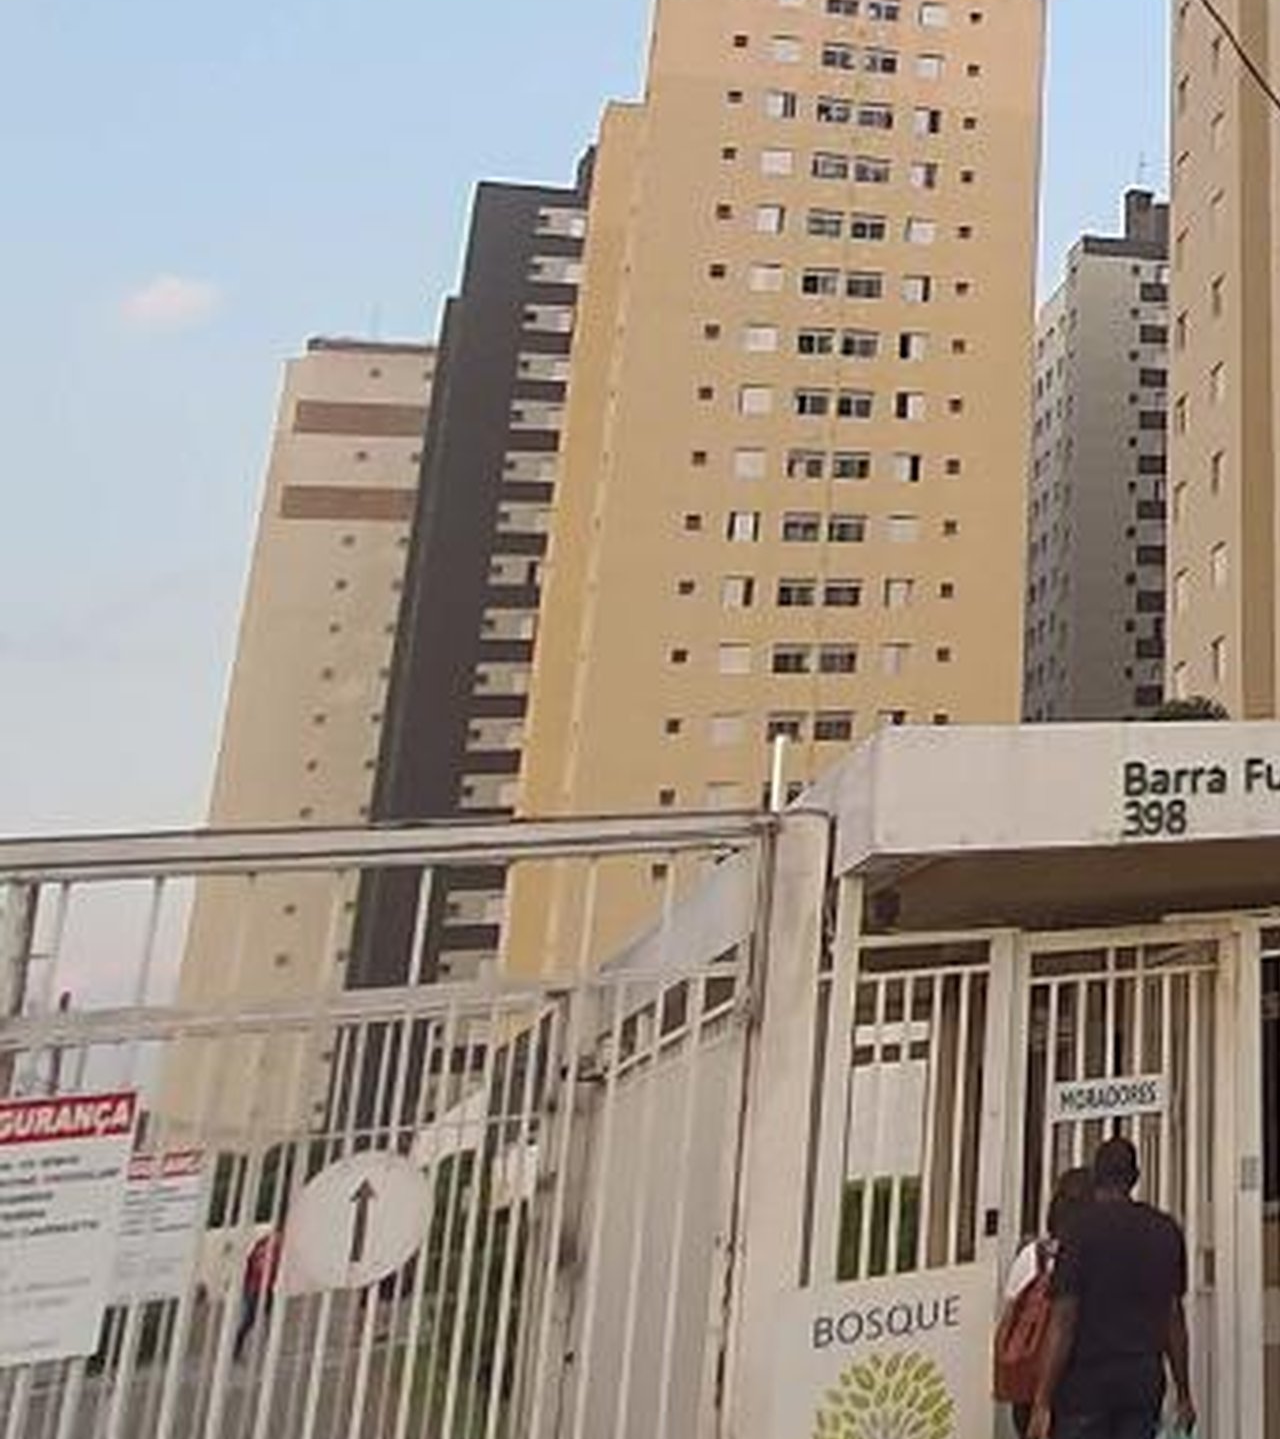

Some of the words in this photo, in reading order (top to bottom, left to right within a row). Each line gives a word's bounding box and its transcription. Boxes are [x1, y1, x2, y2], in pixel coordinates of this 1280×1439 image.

[1122, 761, 1228, 797] Barra
[1121, 799, 1188, 838] 398
[1059, 1080, 1157, 1112] MORADORES
[812, 1295, 961, 1349] BOSQUE
